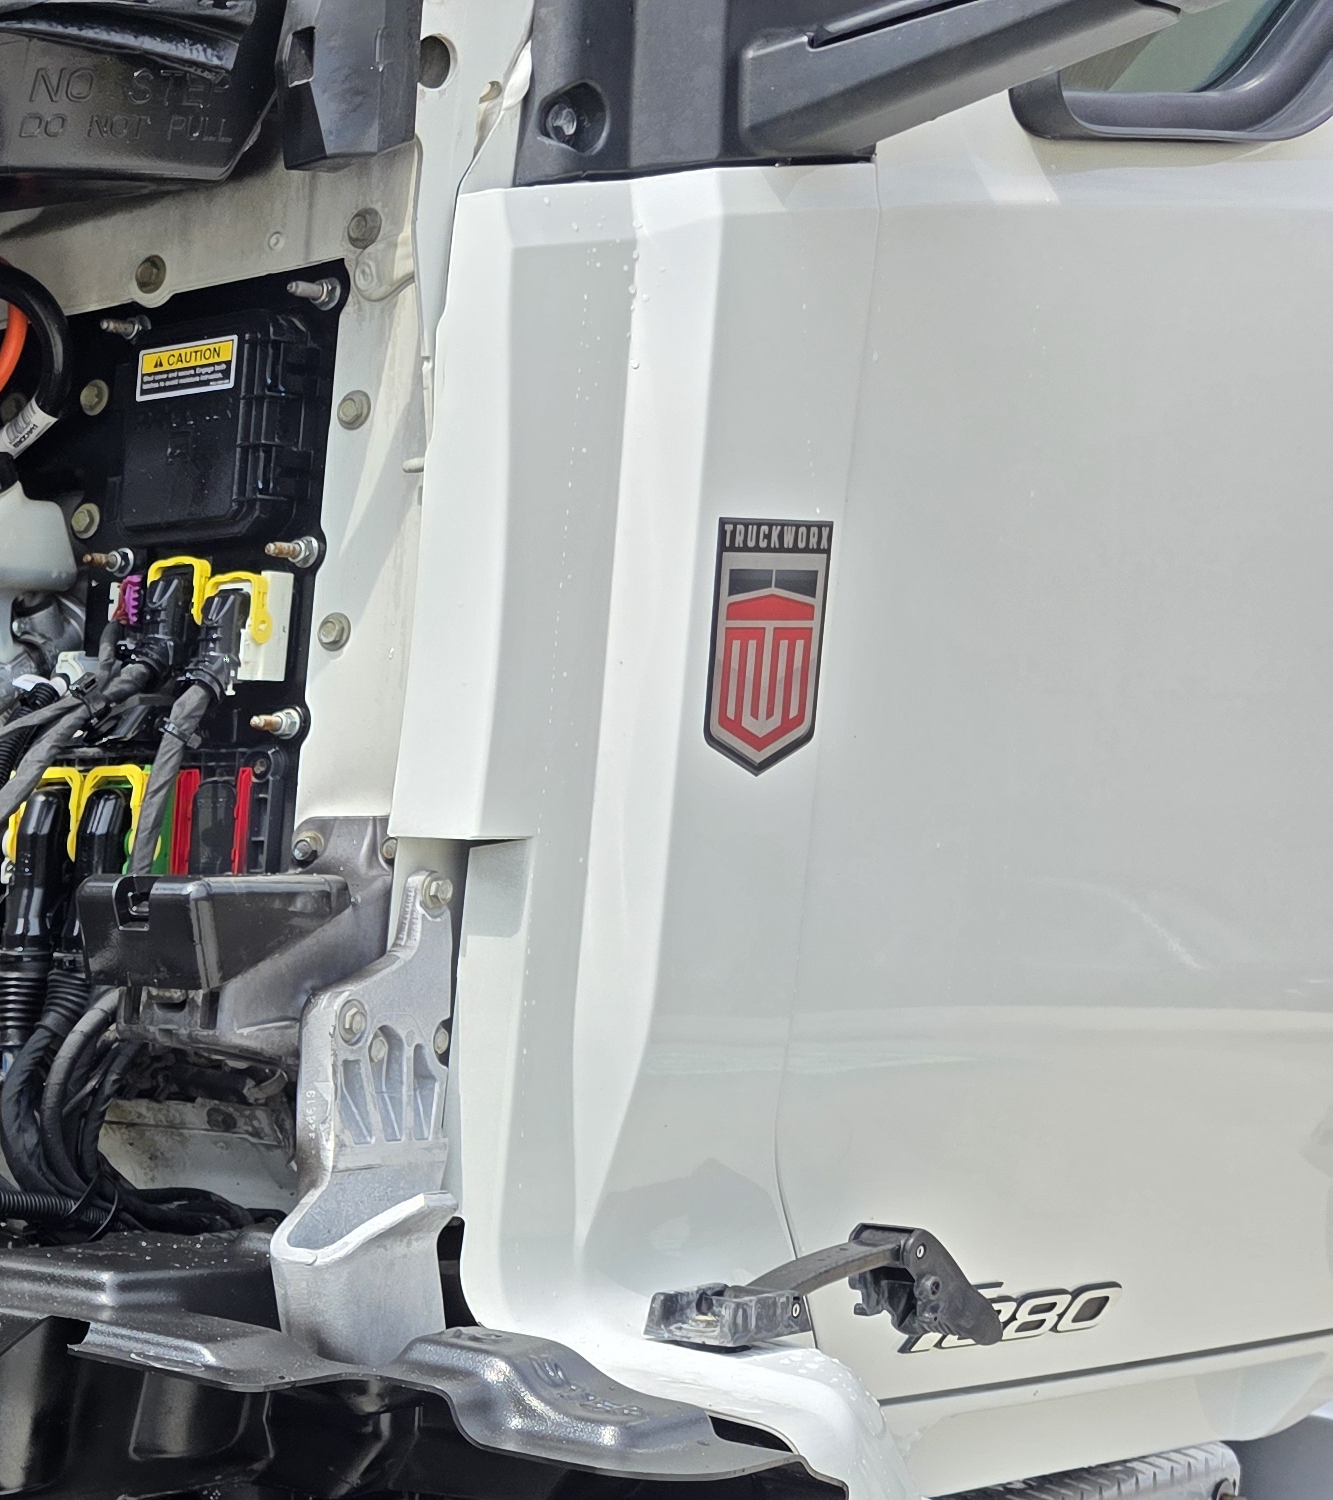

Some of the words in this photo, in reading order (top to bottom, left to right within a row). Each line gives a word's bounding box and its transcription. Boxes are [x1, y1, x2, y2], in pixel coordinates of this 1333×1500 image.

[29, 67, 95, 103] NO
[129, 68, 230, 106] STEP
[18, 113, 67, 139] DO
[87, 114, 152, 140] NOT
[167, 115, 233, 143] PULL
[167, 346, 221, 366] CAUTION
[725, 524, 830, 549] TRUCKWORX
